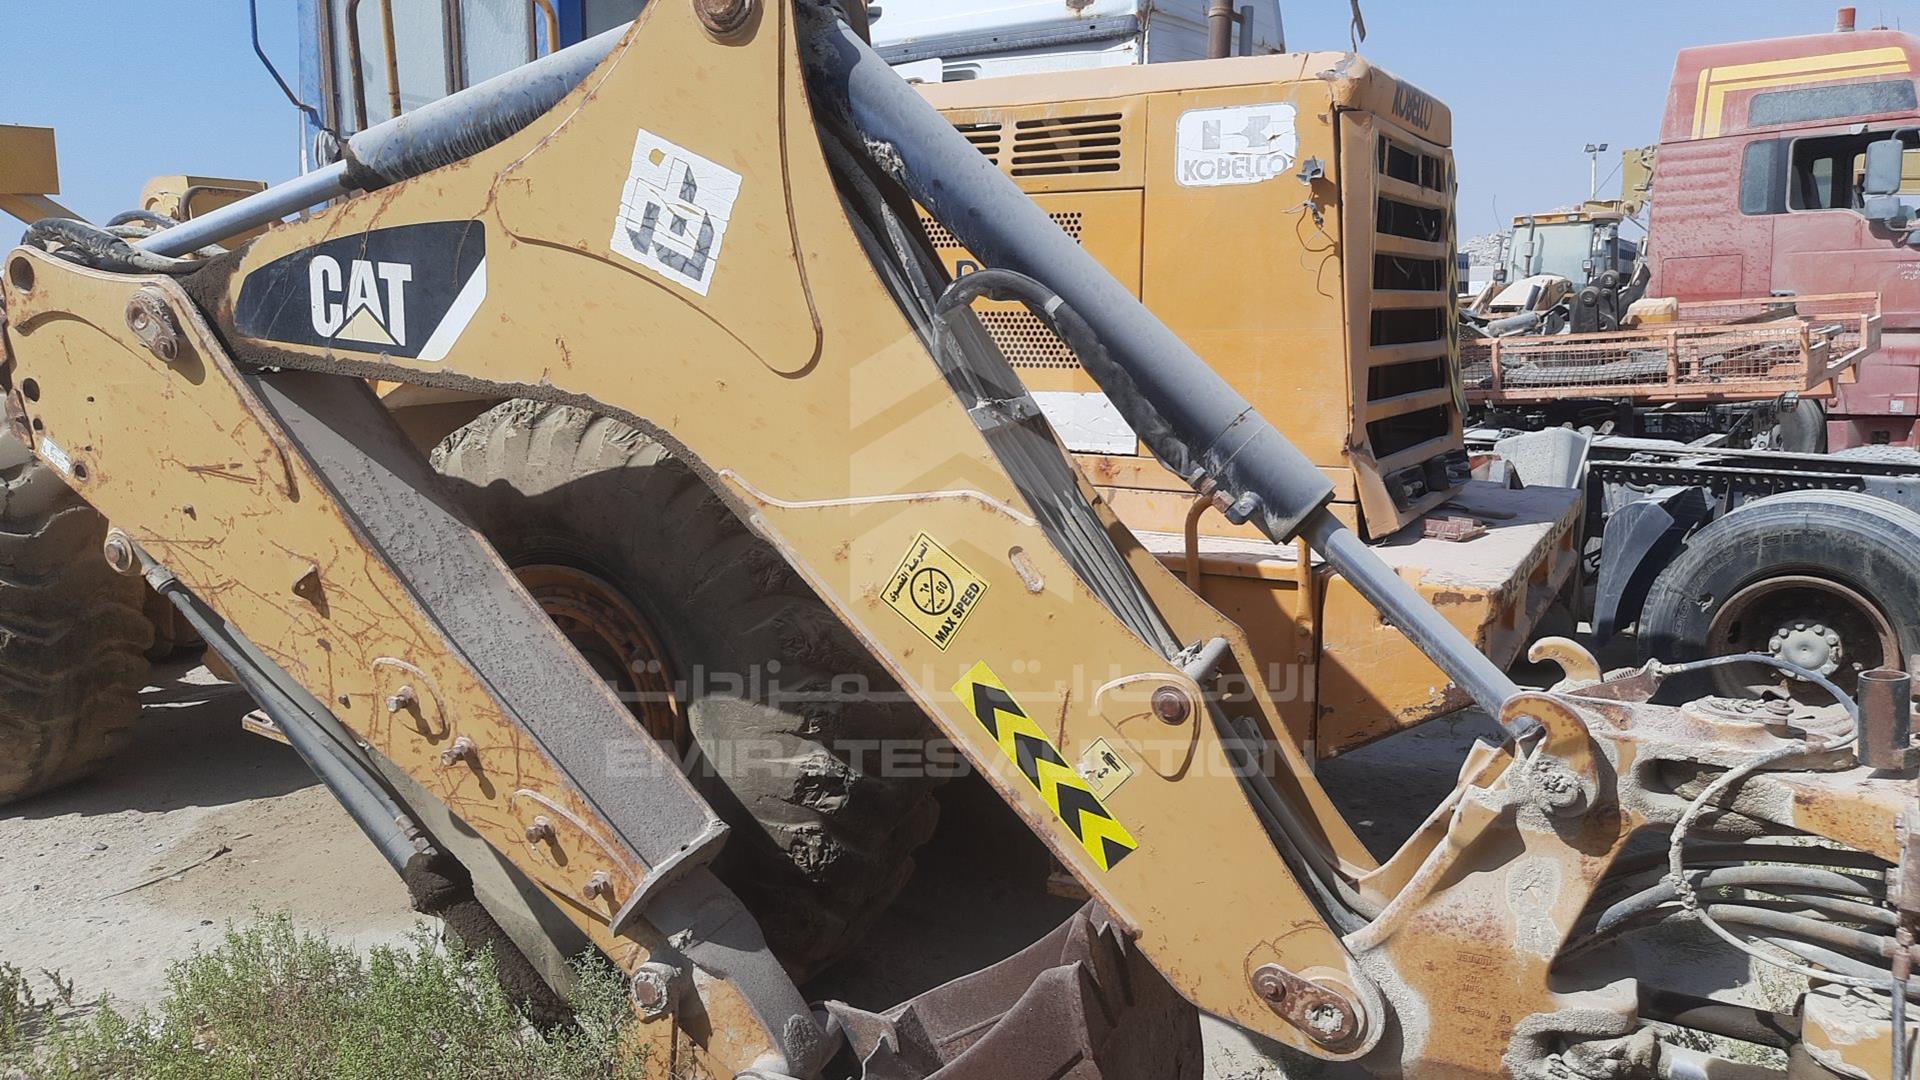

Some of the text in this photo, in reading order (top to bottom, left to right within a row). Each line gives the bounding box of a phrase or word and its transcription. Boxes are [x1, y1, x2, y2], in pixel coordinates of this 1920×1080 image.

[1390, 83, 1432, 131] KOBELCO
[1183, 154, 1288, 181] KOBELCO
[309, 254, 412, 346] CAT
[935, 580, 948, 595] 60
[934, 582, 981, 644] MAX SPEED
